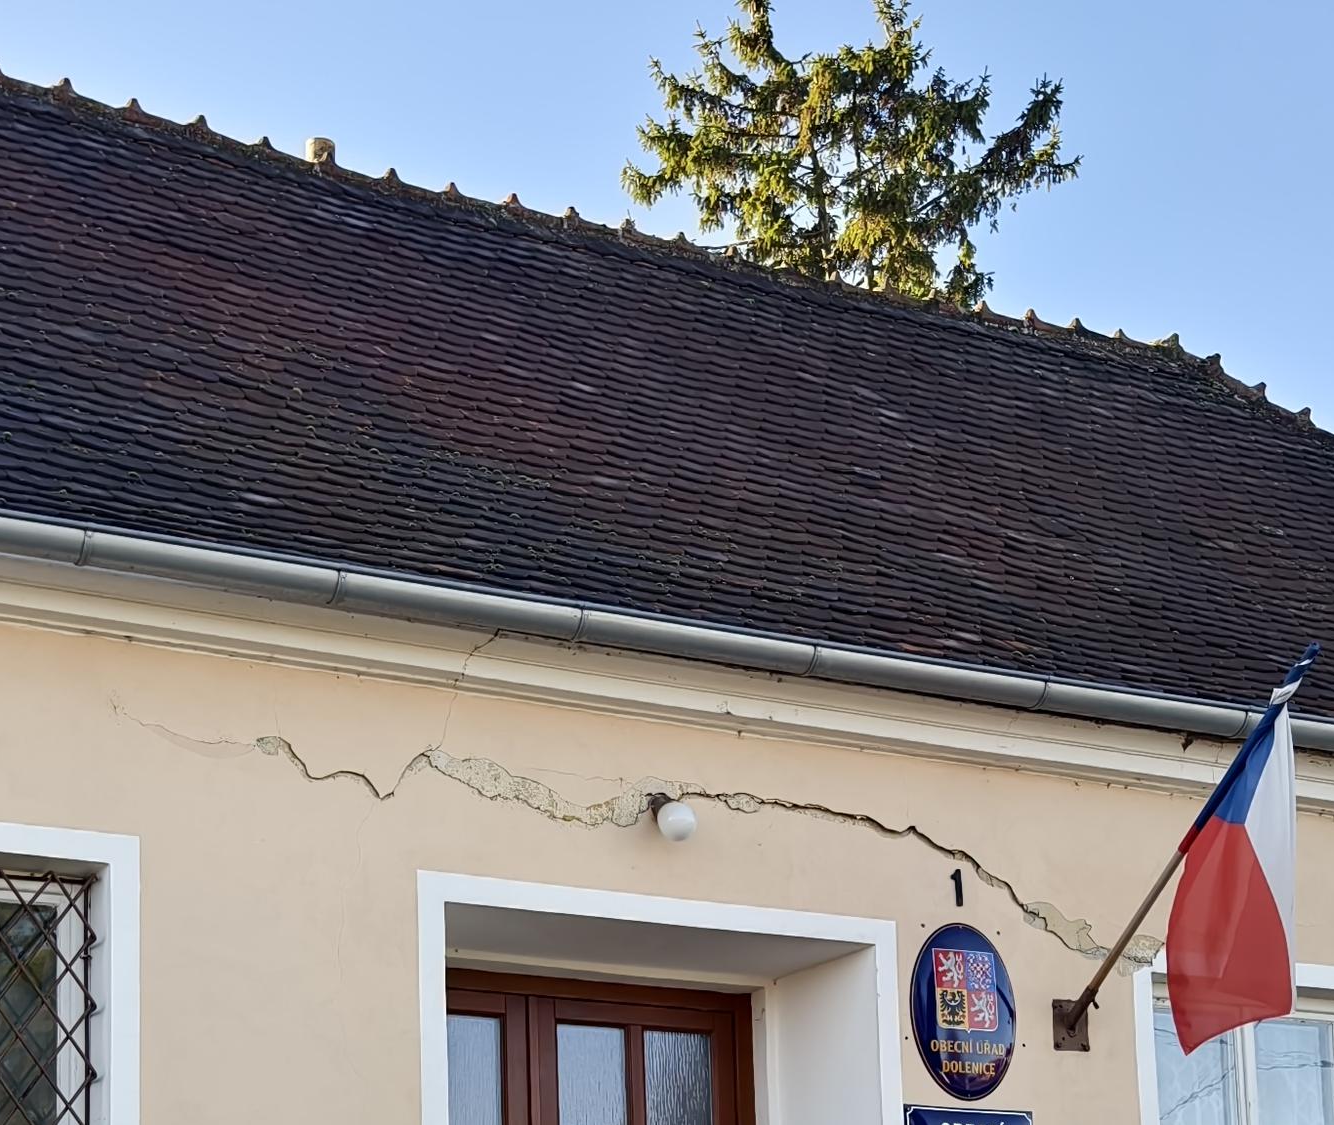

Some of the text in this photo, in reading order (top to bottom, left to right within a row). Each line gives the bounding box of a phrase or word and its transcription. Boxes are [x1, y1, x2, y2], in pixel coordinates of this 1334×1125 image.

[950, 868, 964, 907] 1
[930, 1039, 973, 1054] OBECNÍ
[942, 1060, 996, 1075] DOLENICE
